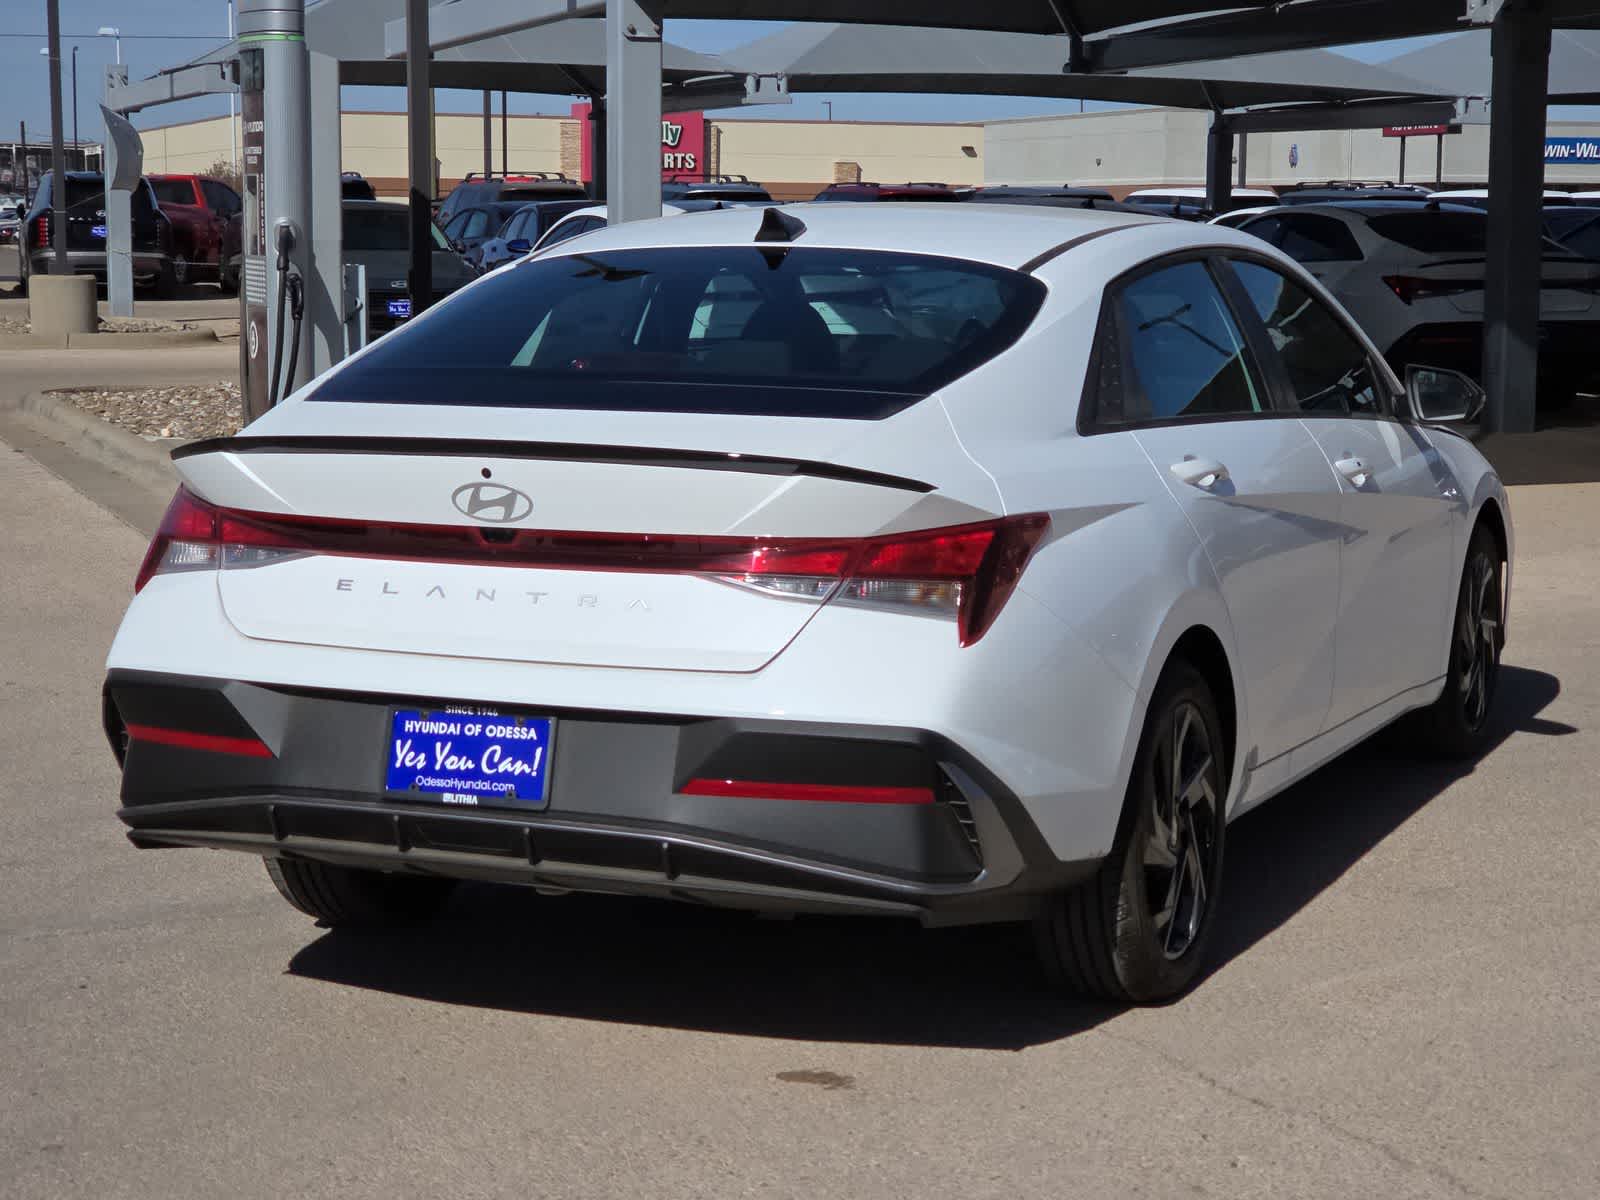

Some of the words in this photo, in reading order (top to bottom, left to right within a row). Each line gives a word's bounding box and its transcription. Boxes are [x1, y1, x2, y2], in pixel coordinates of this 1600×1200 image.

[336, 578, 650, 611] ELANTRA
[445, 705, 474, 716] SINCE
[404, 720, 460, 735] HYUNDAI
[464, 724, 482, 737] OF
[486, 726, 537, 740] ODESSA
[395, 739, 427, 770] Yes
[434, 741, 475, 771] You
[481, 744, 543, 777] Can!
[416, 775, 515, 792] OdessaHyundai.com
[451, 793, 478, 805] LITHIA
